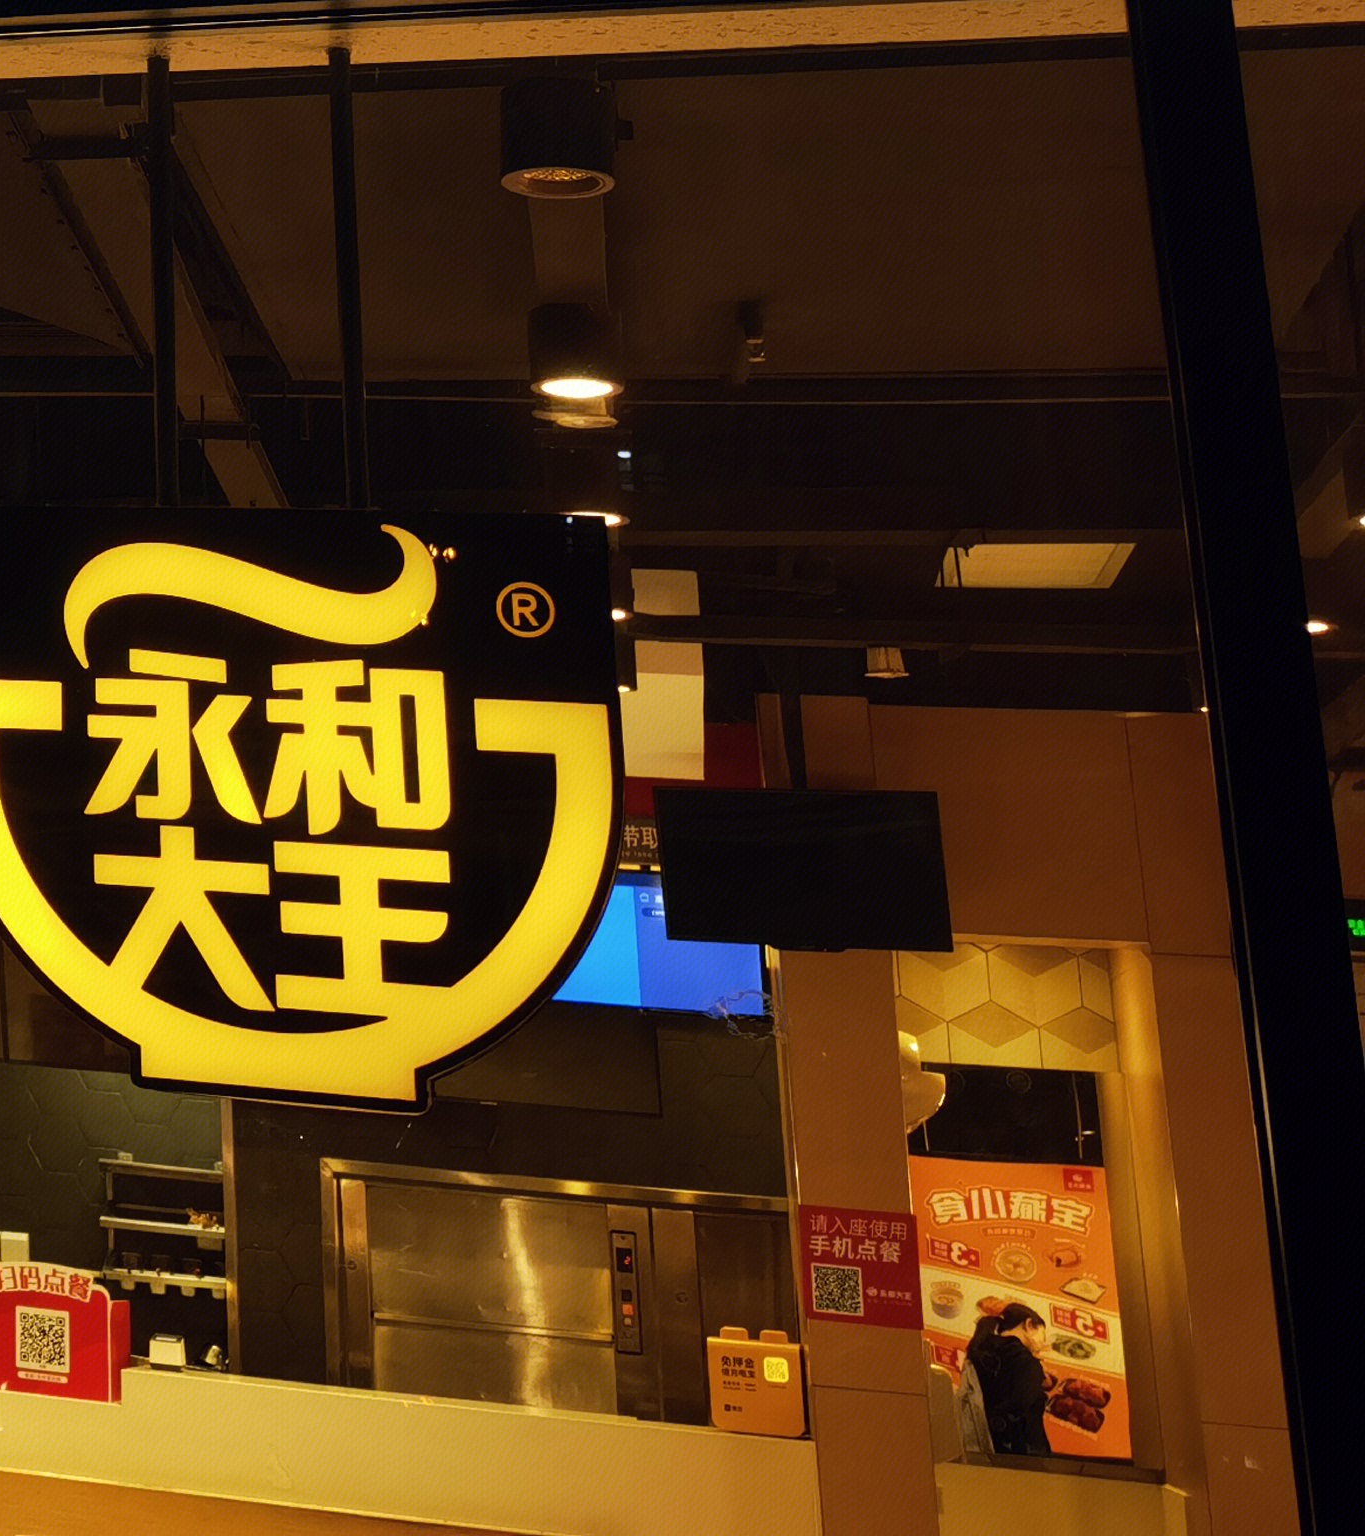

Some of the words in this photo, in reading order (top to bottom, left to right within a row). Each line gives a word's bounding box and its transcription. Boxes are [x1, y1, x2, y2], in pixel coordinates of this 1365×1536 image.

[84, 649, 451, 835] 永和
[94, 826, 451, 1016] 大王
[809, 1214, 907, 1241] 请入座使用
[809, 1235, 901, 1263] 手机点餐
